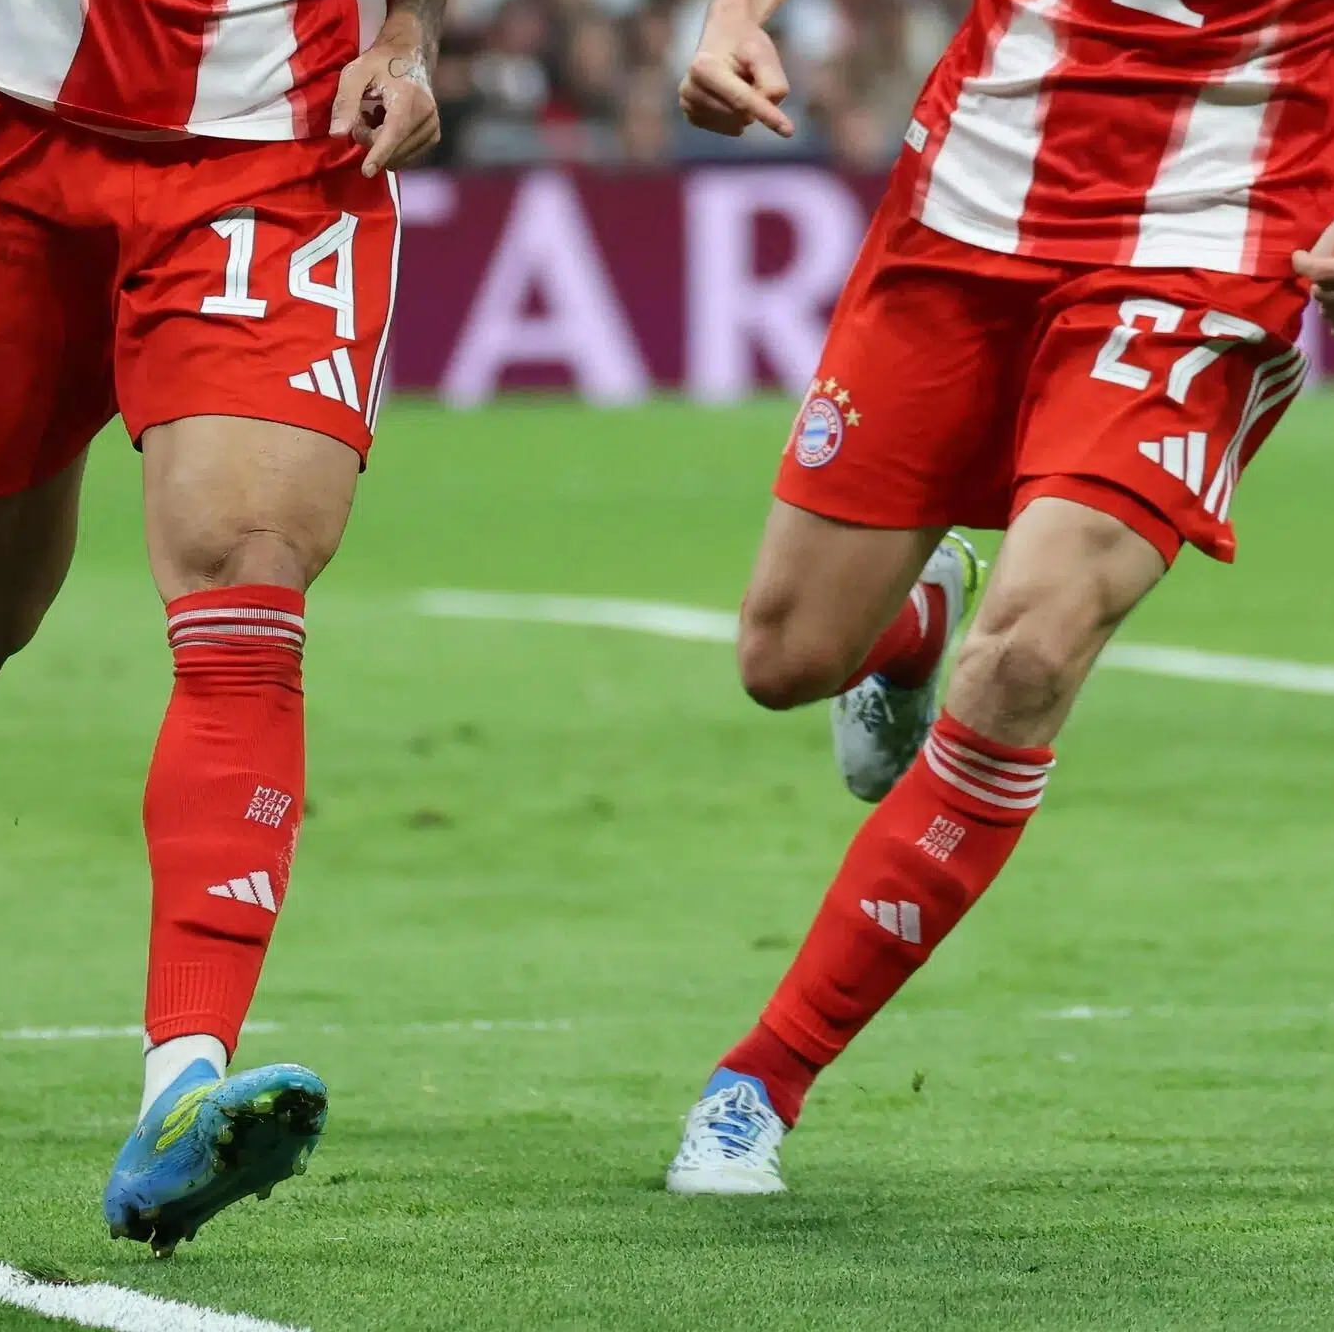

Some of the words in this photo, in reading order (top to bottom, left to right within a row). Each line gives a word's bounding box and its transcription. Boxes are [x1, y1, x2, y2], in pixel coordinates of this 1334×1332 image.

[200, 206, 359, 341] 14
[1090, 296, 1266, 404] 27
[254, 785, 292, 807] MIA
[244, 807, 281, 829] MIA
[250, 797, 285, 818] SAN
